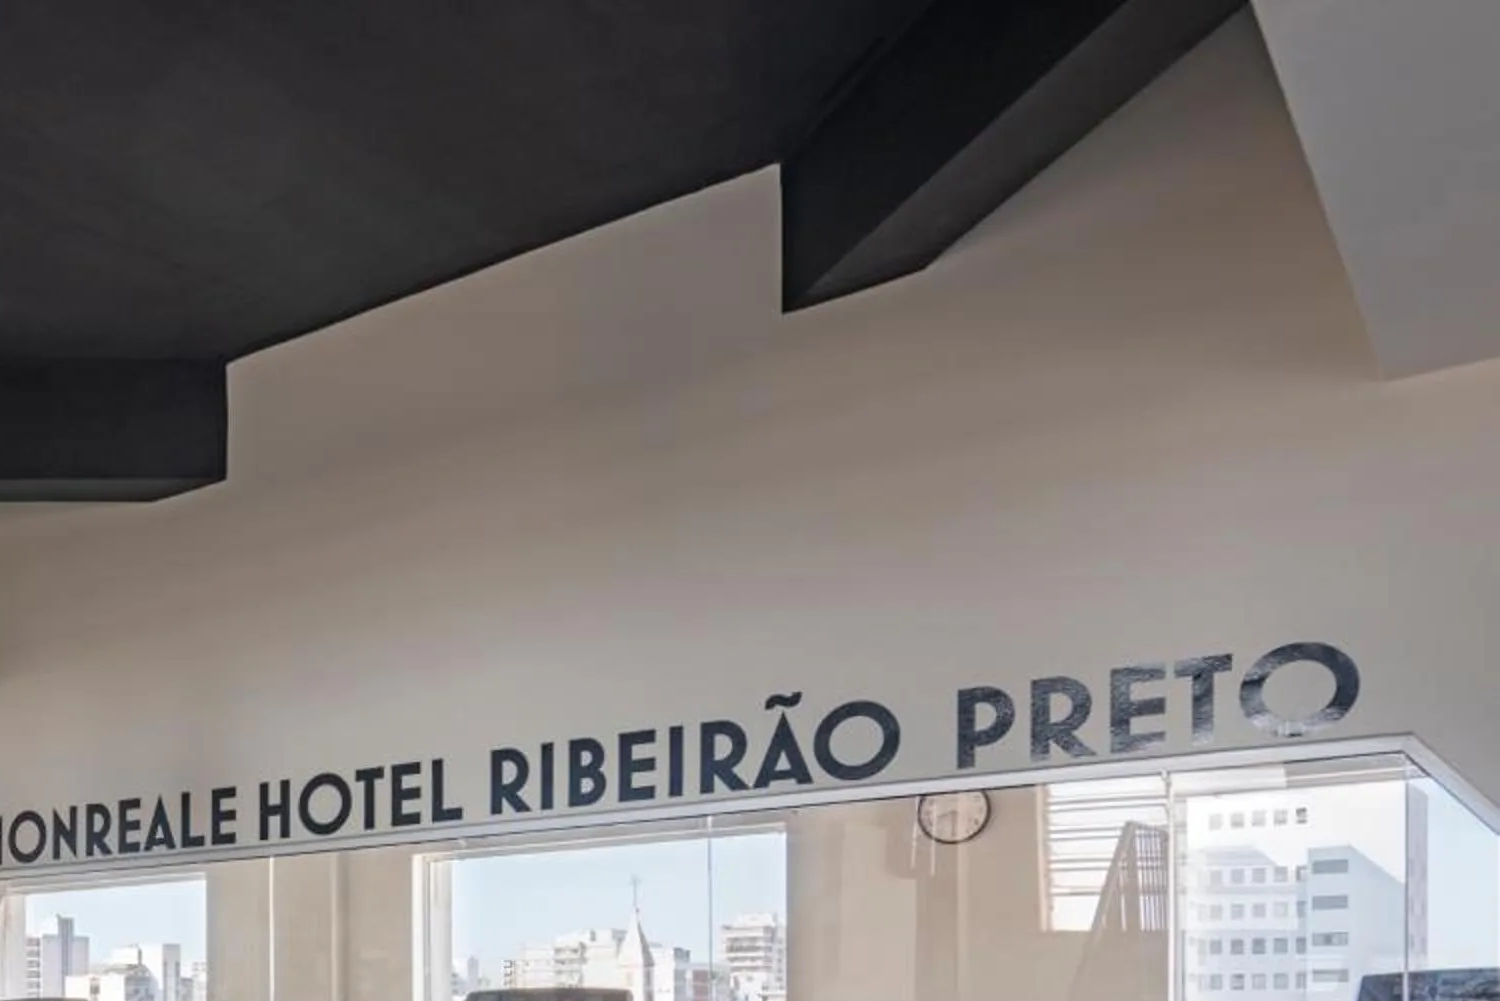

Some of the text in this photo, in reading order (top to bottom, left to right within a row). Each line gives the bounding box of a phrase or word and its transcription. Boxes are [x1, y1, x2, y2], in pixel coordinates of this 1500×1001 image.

[258, 757, 463, 841] HOTEL
[489, 691, 901, 817] RIBEIRÃO
[955, 641, 1361, 771] PRETO
